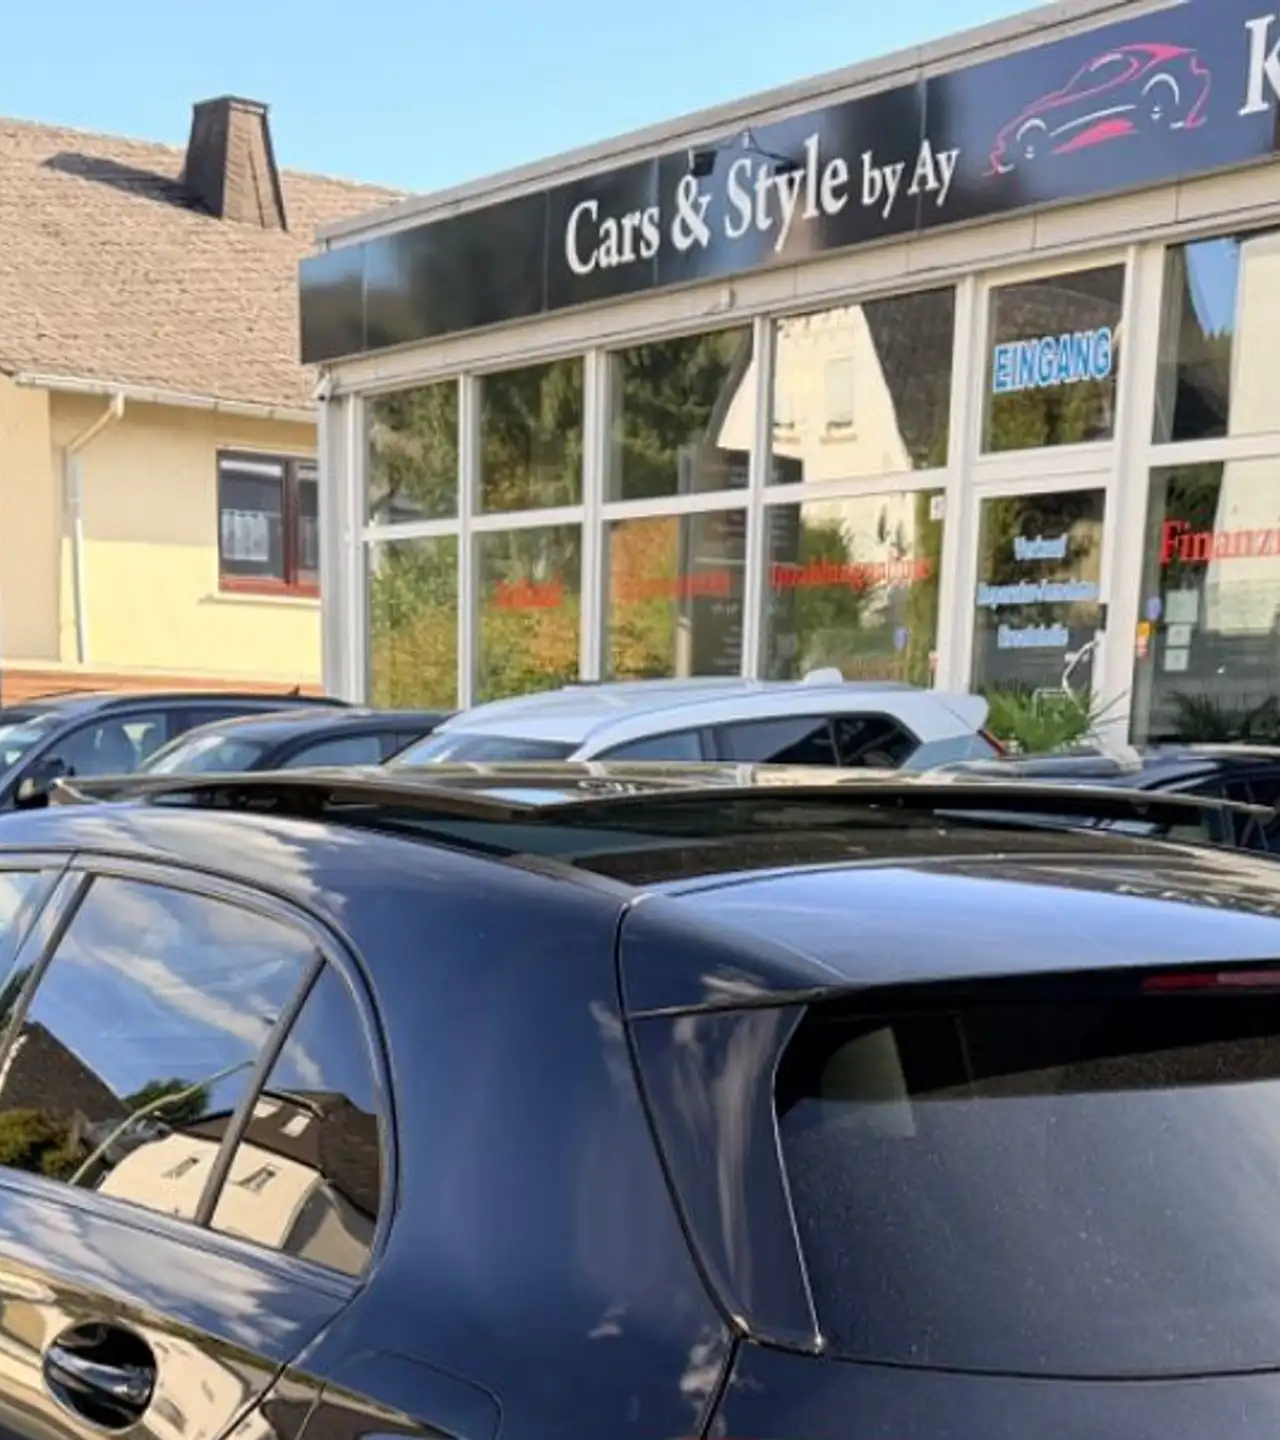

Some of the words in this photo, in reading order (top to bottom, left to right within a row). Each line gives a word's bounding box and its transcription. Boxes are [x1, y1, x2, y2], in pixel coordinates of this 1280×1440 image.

[565, 200, 660, 275] Cars
[670, 175, 713, 249] &
[723, 132, 849, 252] Style
[862, 150, 905, 219] by
[908, 139, 960, 206] Ay
[993, 326, 1111, 393] EINGANG
